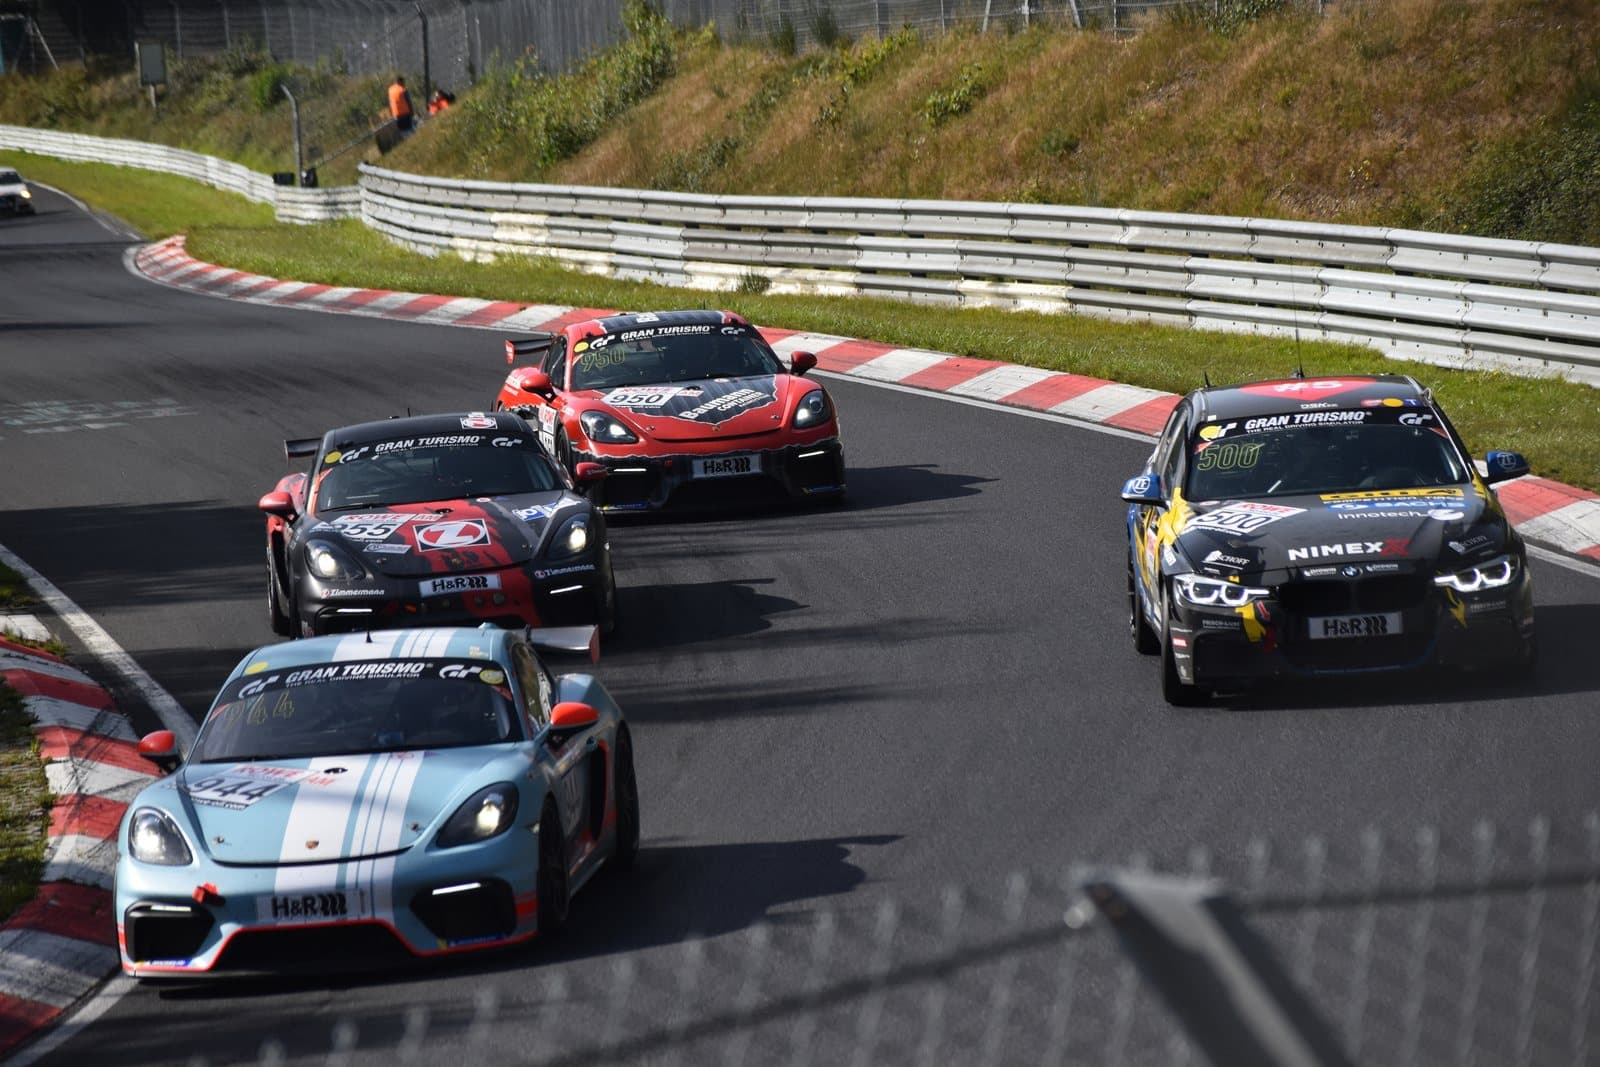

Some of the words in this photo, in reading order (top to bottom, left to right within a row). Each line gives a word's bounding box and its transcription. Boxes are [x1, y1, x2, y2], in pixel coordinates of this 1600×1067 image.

[621, 328, 654, 340] GRAN
[657, 325, 710, 334] TURISMO
[580, 349, 625, 372] 950
[610, 394, 664, 403] 950
[679, 388, 756, 420] Baumann
[1244, 416, 1289, 429] GRAN
[1294, 411, 1365, 424] TURISMO
[375, 440, 414, 452] GRAN
[418, 435, 480, 446] TURISMO
[1197, 442, 1261, 471] 500
[1197, 511, 1273, 529] 500
[285, 666, 339, 684] GRAN
[342, 662, 426, 676] TURISMO
